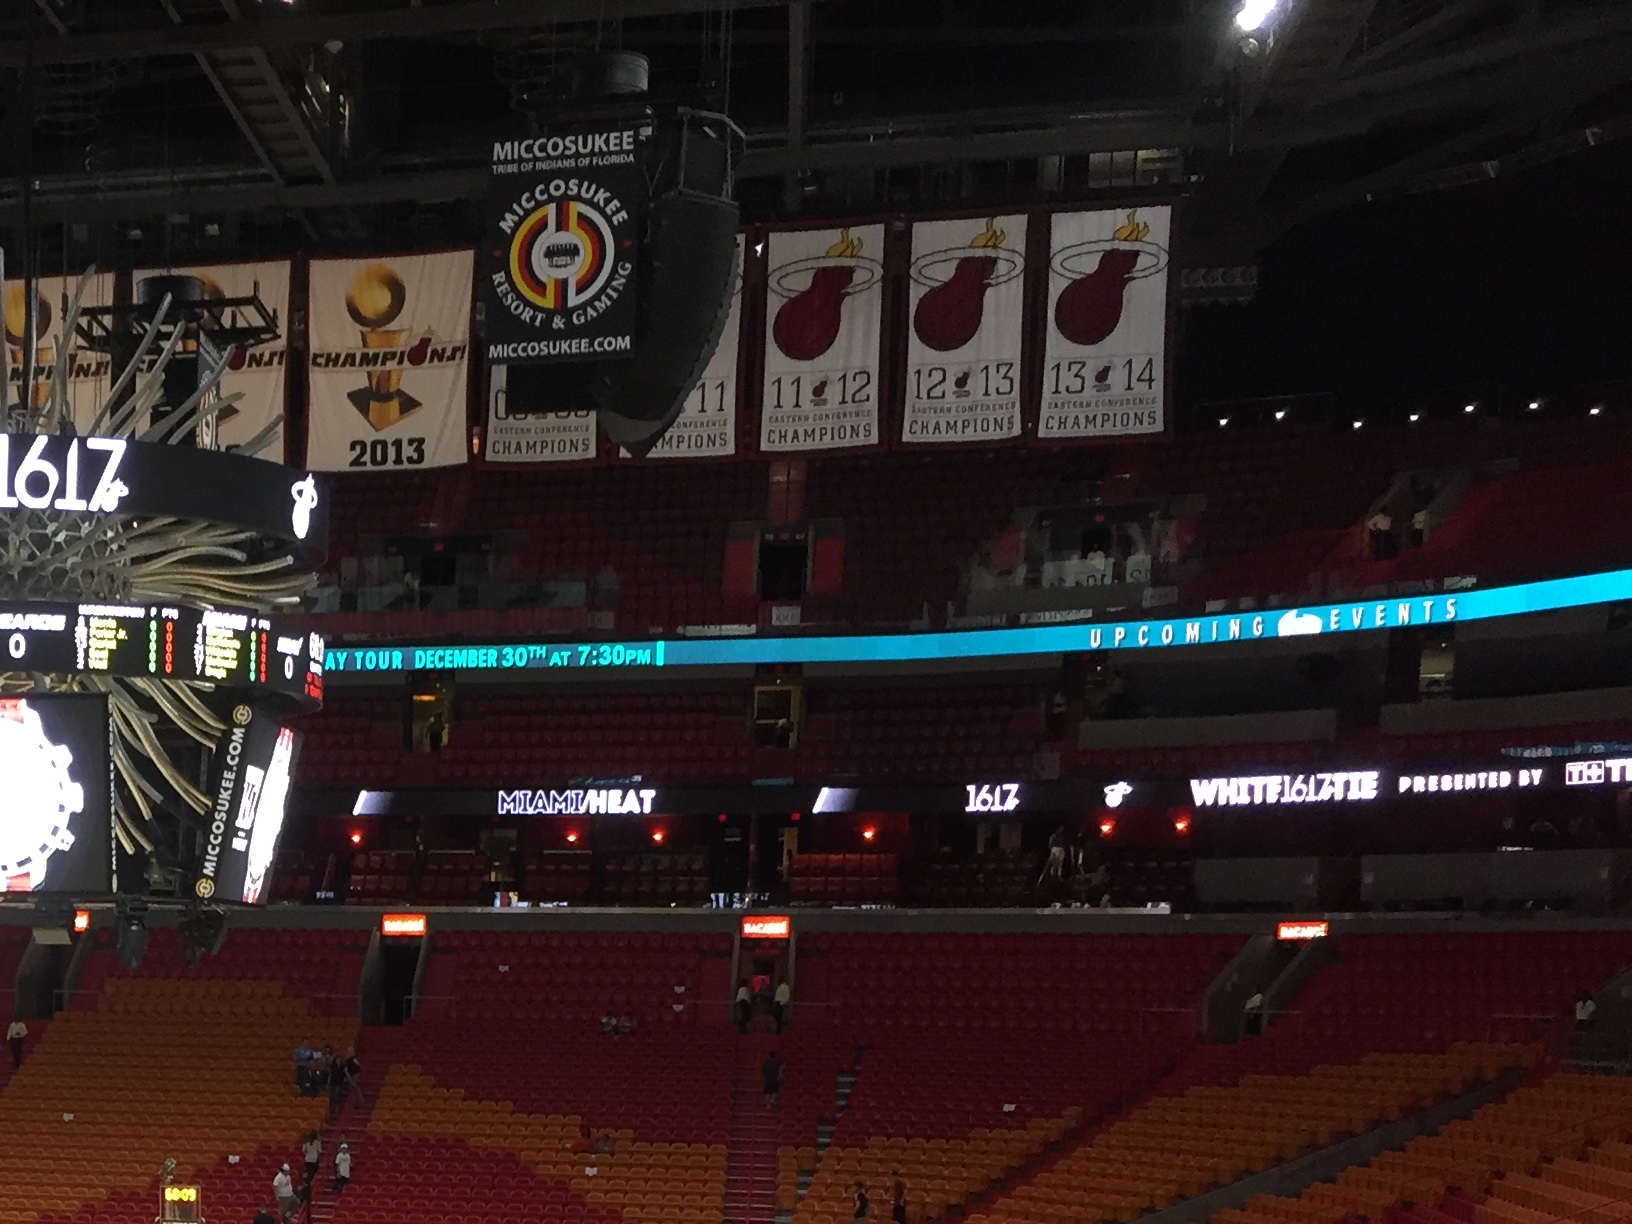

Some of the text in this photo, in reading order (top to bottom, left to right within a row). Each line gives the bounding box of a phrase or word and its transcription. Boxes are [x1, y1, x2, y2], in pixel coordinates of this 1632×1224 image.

[492, 130, 634, 162] MICCOSUKEE
[492, 153, 635, 175] TRIBE OF INDIANS OF FLORIDA
[498, 179, 629, 234] MICCOSUKEE
[492, 261, 632, 330] RESORT & GAMING
[489, 336, 631, 359] MICCOSUKEE.COM
[771, 369, 870, 409] 11 12
[913, 362, 1014, 400] 12 13
[1050, 358, 1156, 395] 13 14
[955, 401, 1016, 413] CONFERENCE
[1094, 396, 1157, 408] CONFERENCE
[768, 411, 809, 424] EASTERN
[909, 415, 1015, 435] CHAMPIONS
[1045, 410, 1157, 431] CHAMPIONS
[492, 438, 589, 455] CHAMPIONS
[768, 423, 872, 445] CHAMPIONS
[349, 439, 425, 467] 2013
[1090, 599, 1457, 648] UPCOMING EVENTS
[9, 633, 26, 658] 0
[354, 645, 651, 671] TOUR DECEMBER 30TH AT 7:30PM
[1399, 769, 1543, 793] PRESENTED BY
[203, 727, 245, 876] MICCOSUKEE.COM
[965, 784, 1019, 811] 1617
